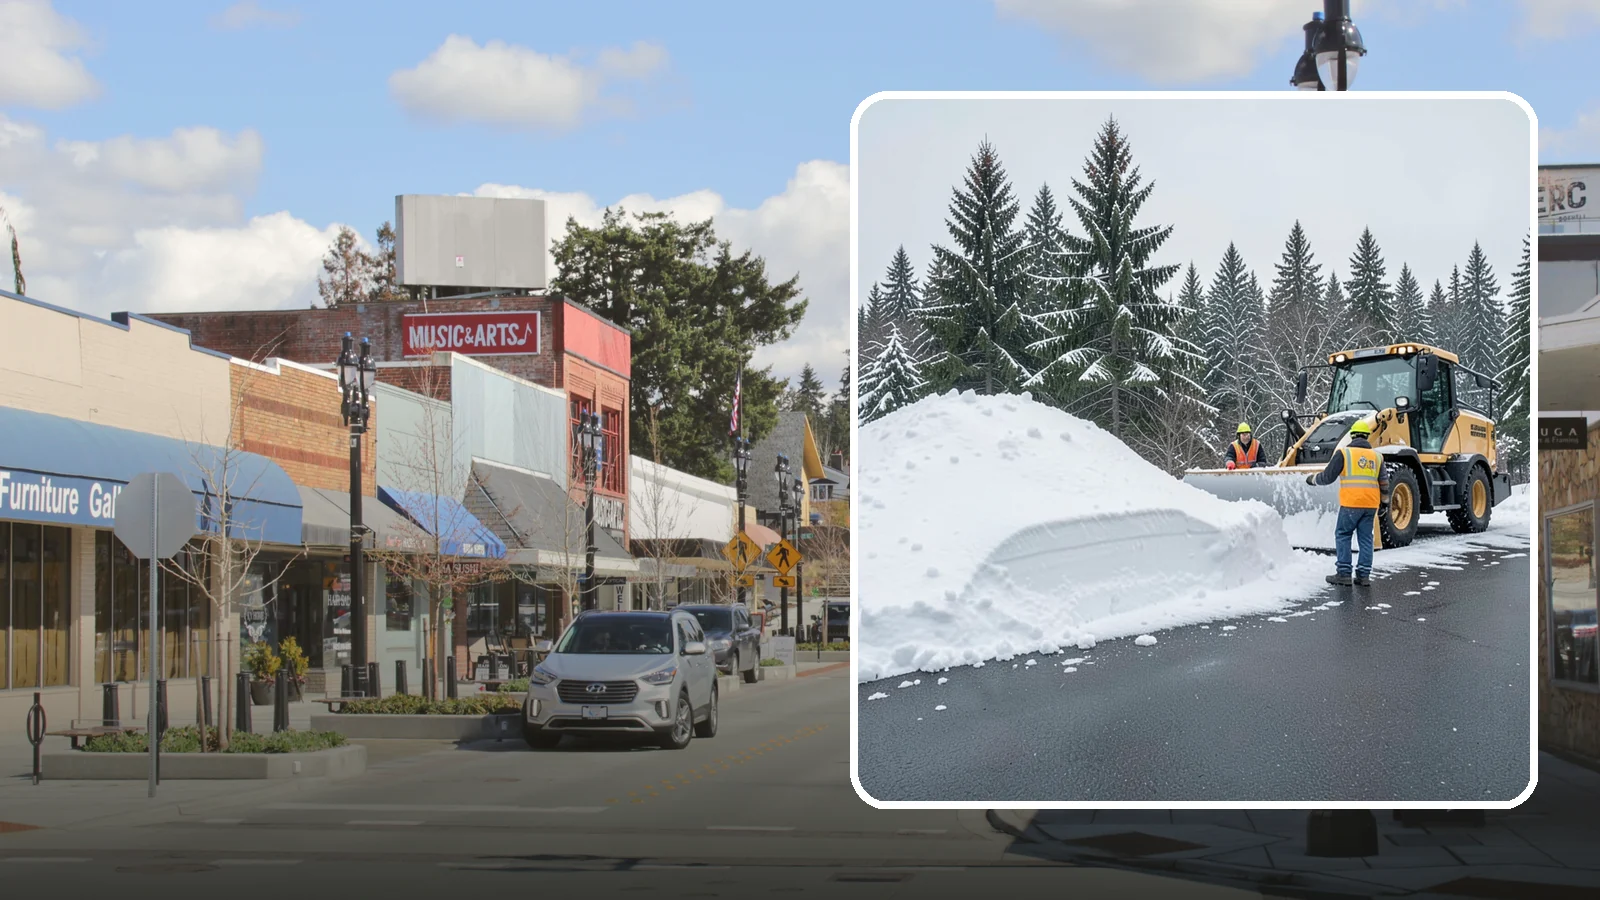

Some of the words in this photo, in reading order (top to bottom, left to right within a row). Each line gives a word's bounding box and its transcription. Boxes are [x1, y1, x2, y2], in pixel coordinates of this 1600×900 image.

[408, 322, 519, 349] MUSIC&ARTS
[0, 472, 79, 515] Furniture
[90, 483, 122, 519] Gal
[453, 563, 479, 574] SUSHI
